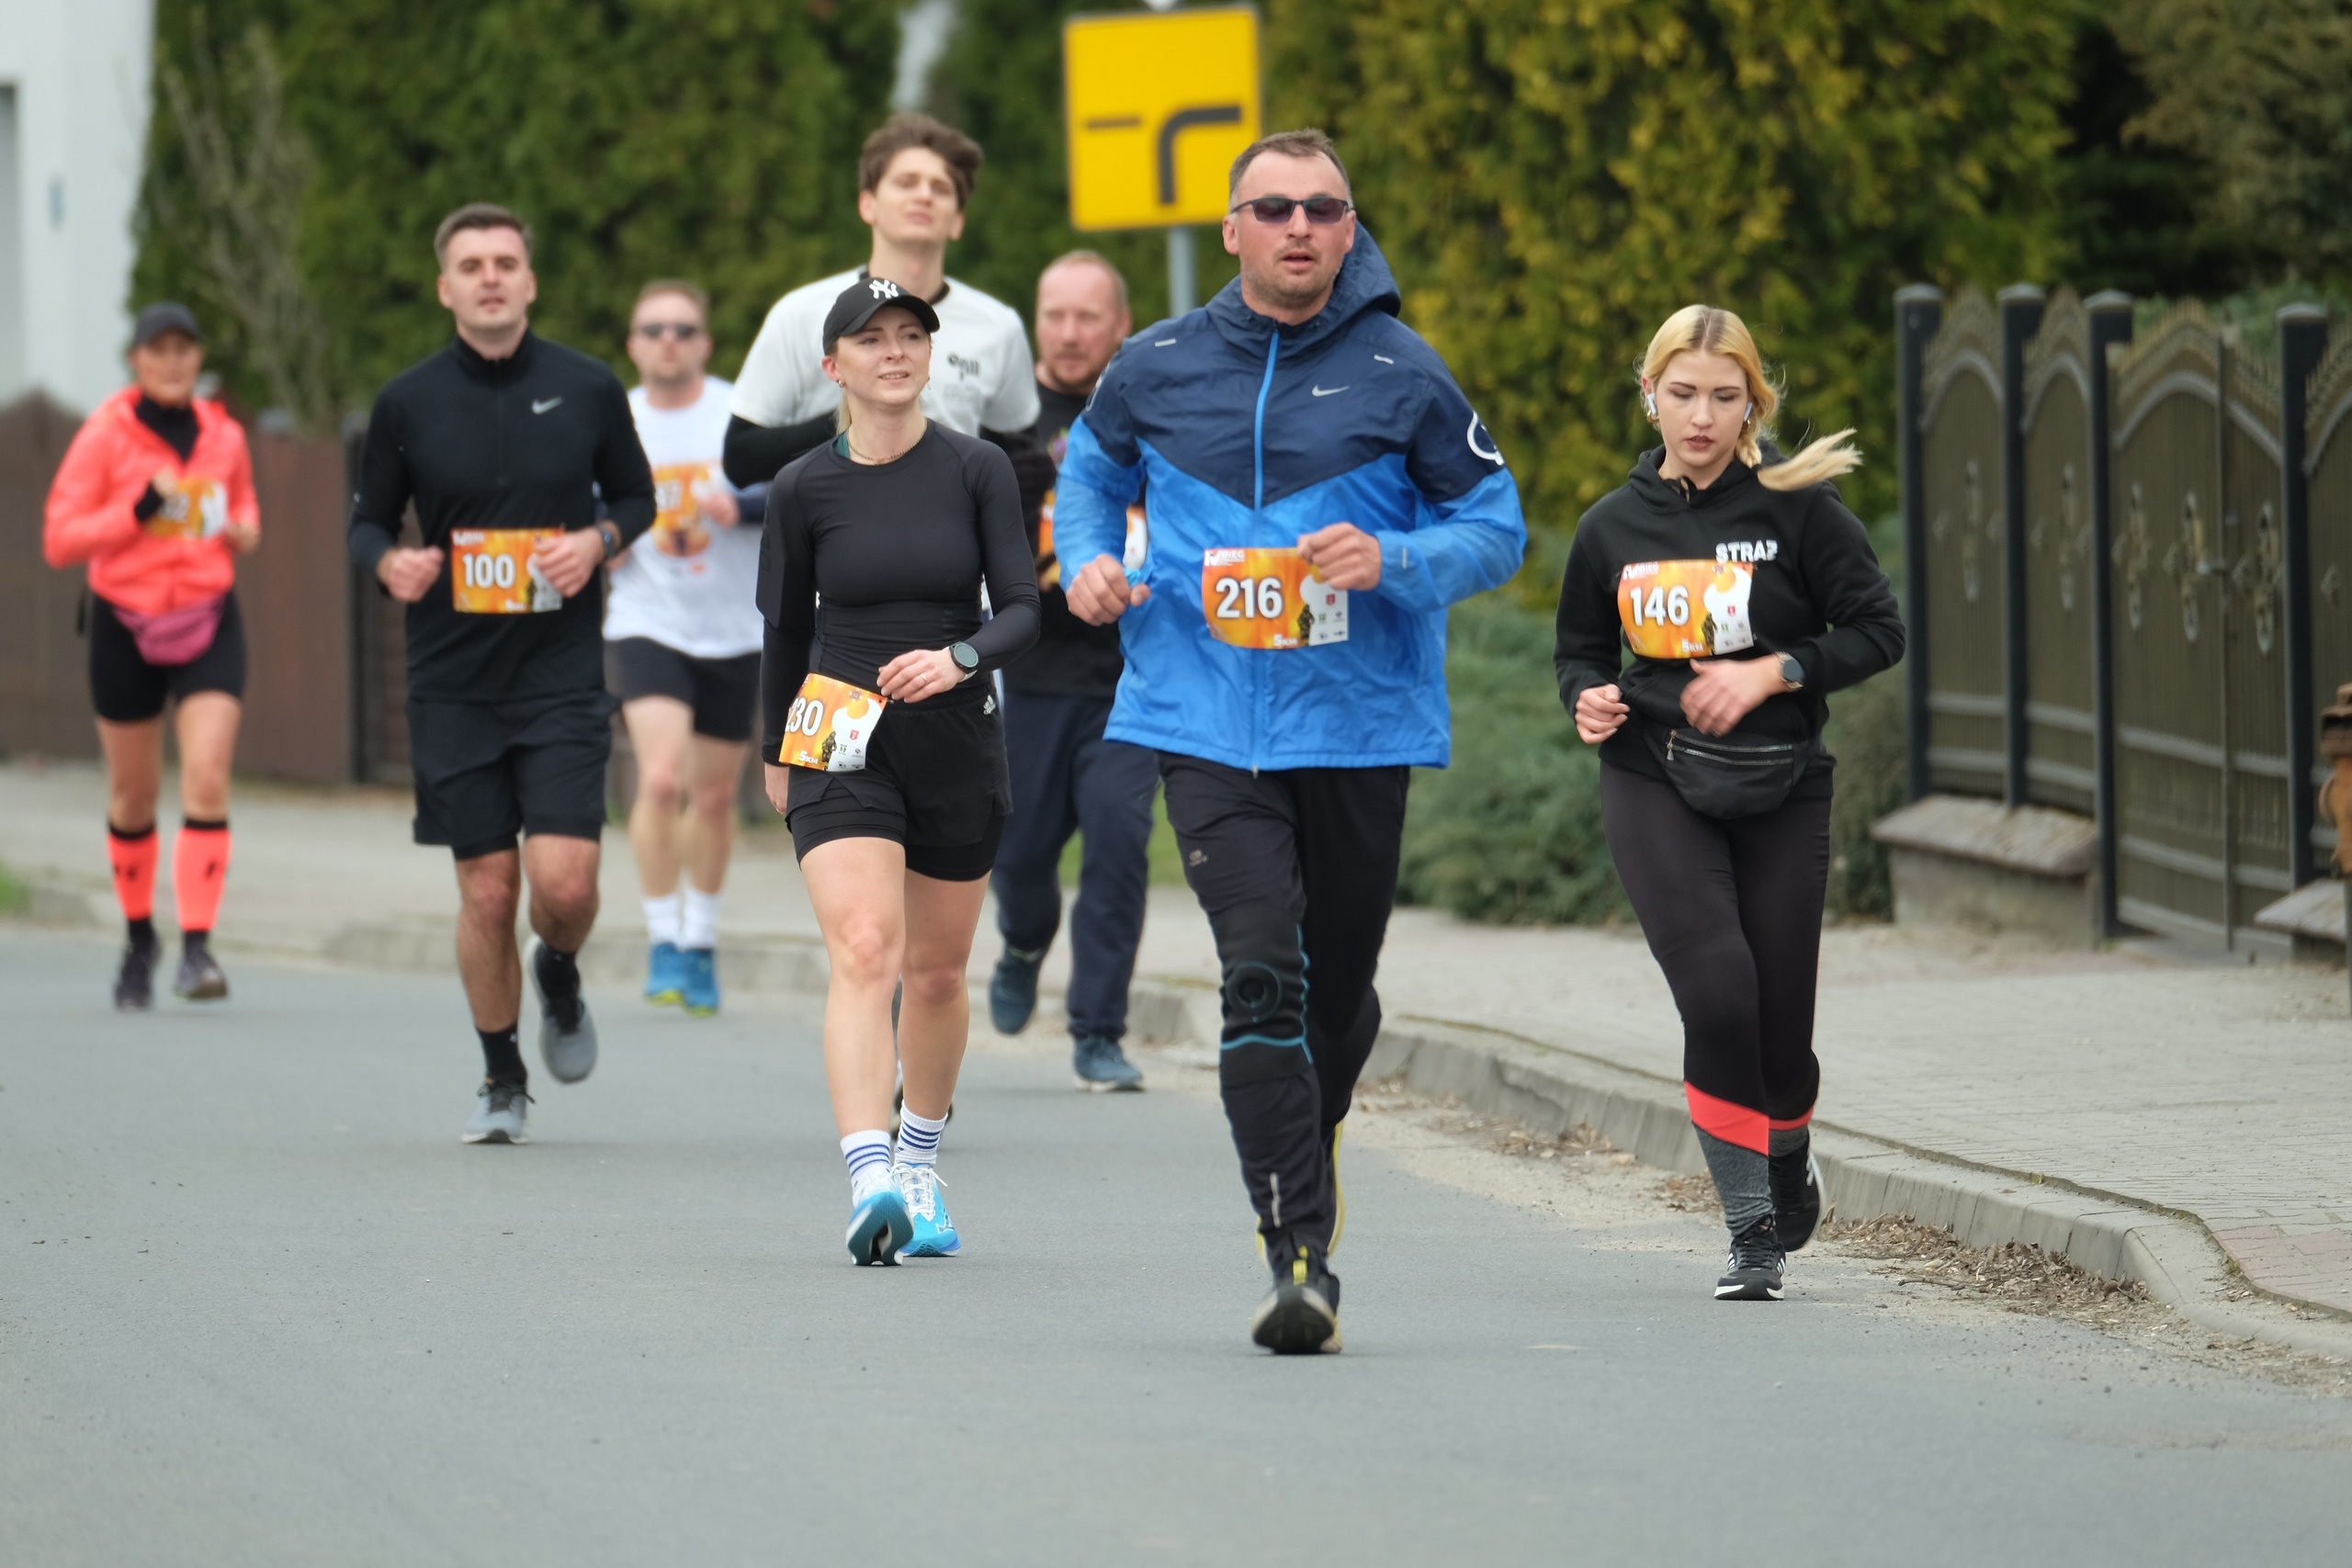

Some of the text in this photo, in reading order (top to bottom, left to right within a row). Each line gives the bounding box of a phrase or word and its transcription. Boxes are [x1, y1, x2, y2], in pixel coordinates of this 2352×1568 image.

[868, 279, 899, 299] NY
[462, 553, 515, 589] 100
[1216, 577, 1283, 619] 216
[1630, 585, 1690, 626] 146
[798, 750, 819, 764] 5KM
